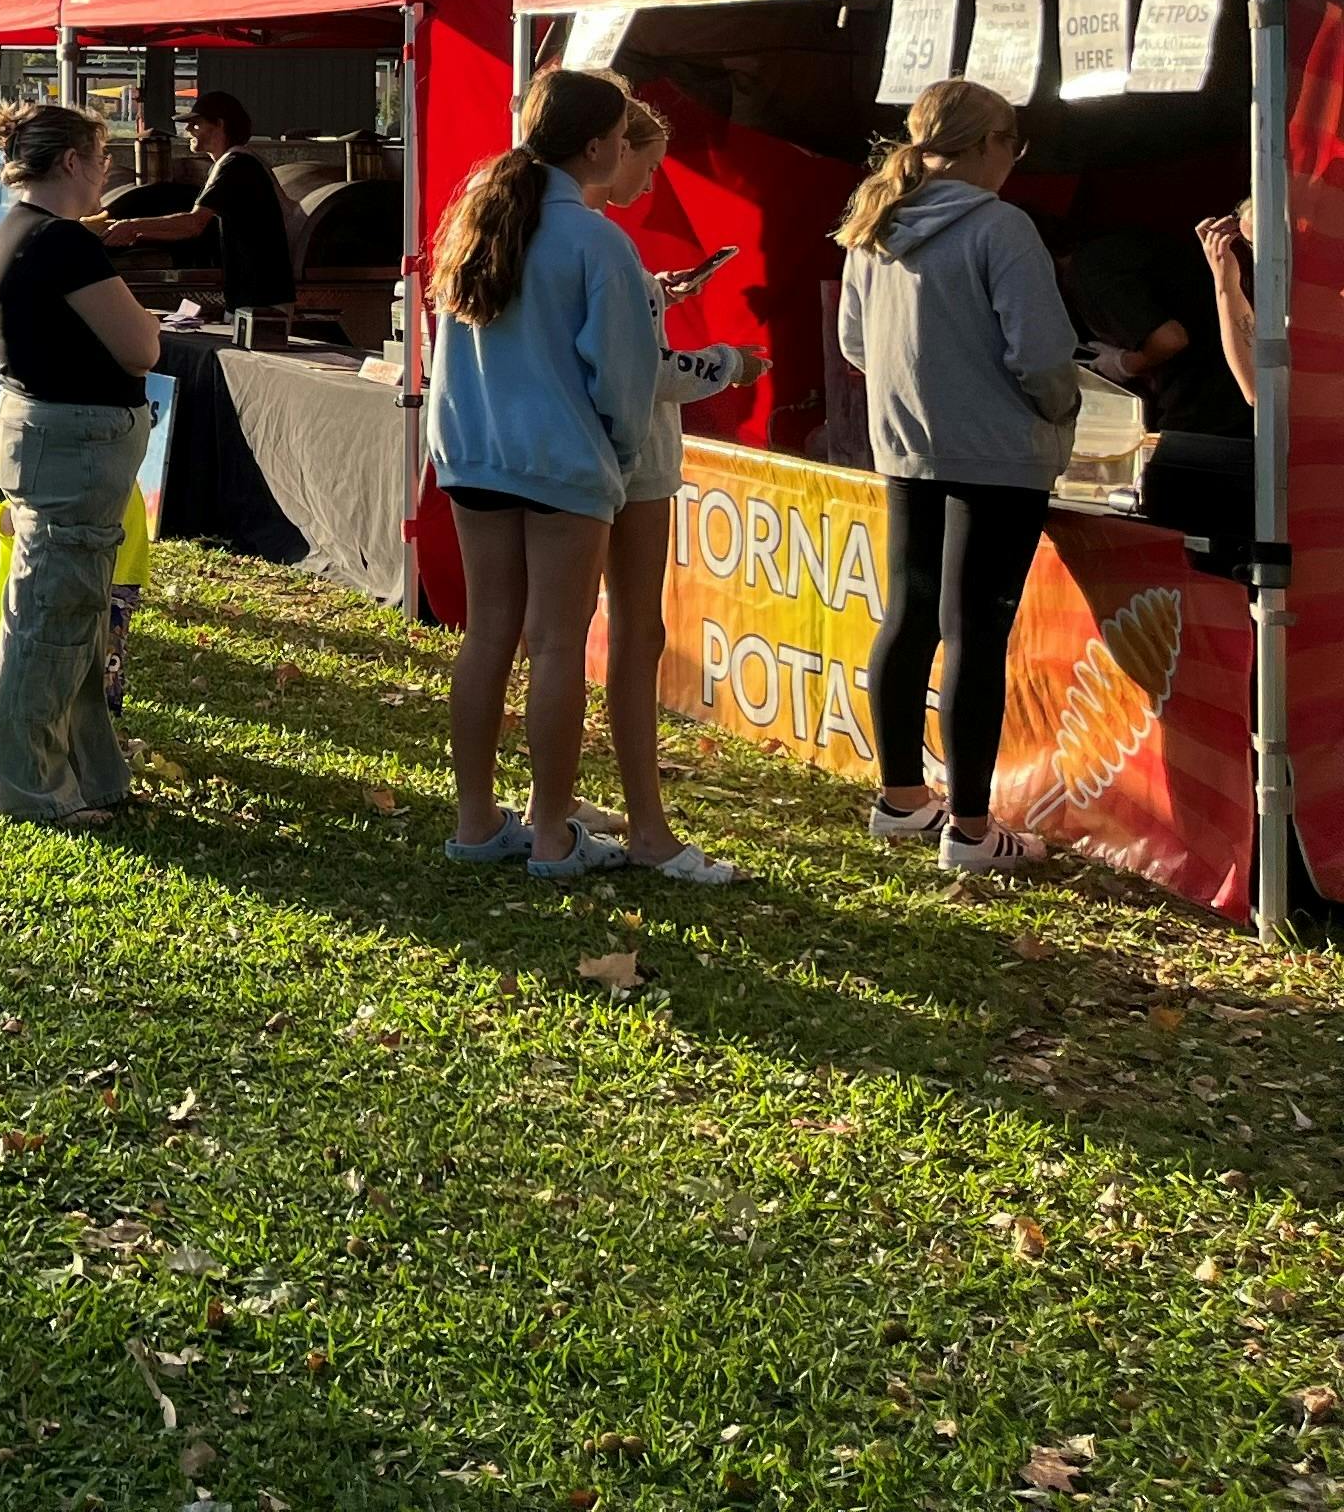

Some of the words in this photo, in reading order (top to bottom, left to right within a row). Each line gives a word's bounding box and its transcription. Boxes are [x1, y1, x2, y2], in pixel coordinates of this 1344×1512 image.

[1066, 12, 1120, 36] ORDER
[903, 35, 935, 75] $9
[1075, 48, 1114, 71] HERE
[659, 347, 722, 382] YORK
[672, 480, 885, 624] TORNA
